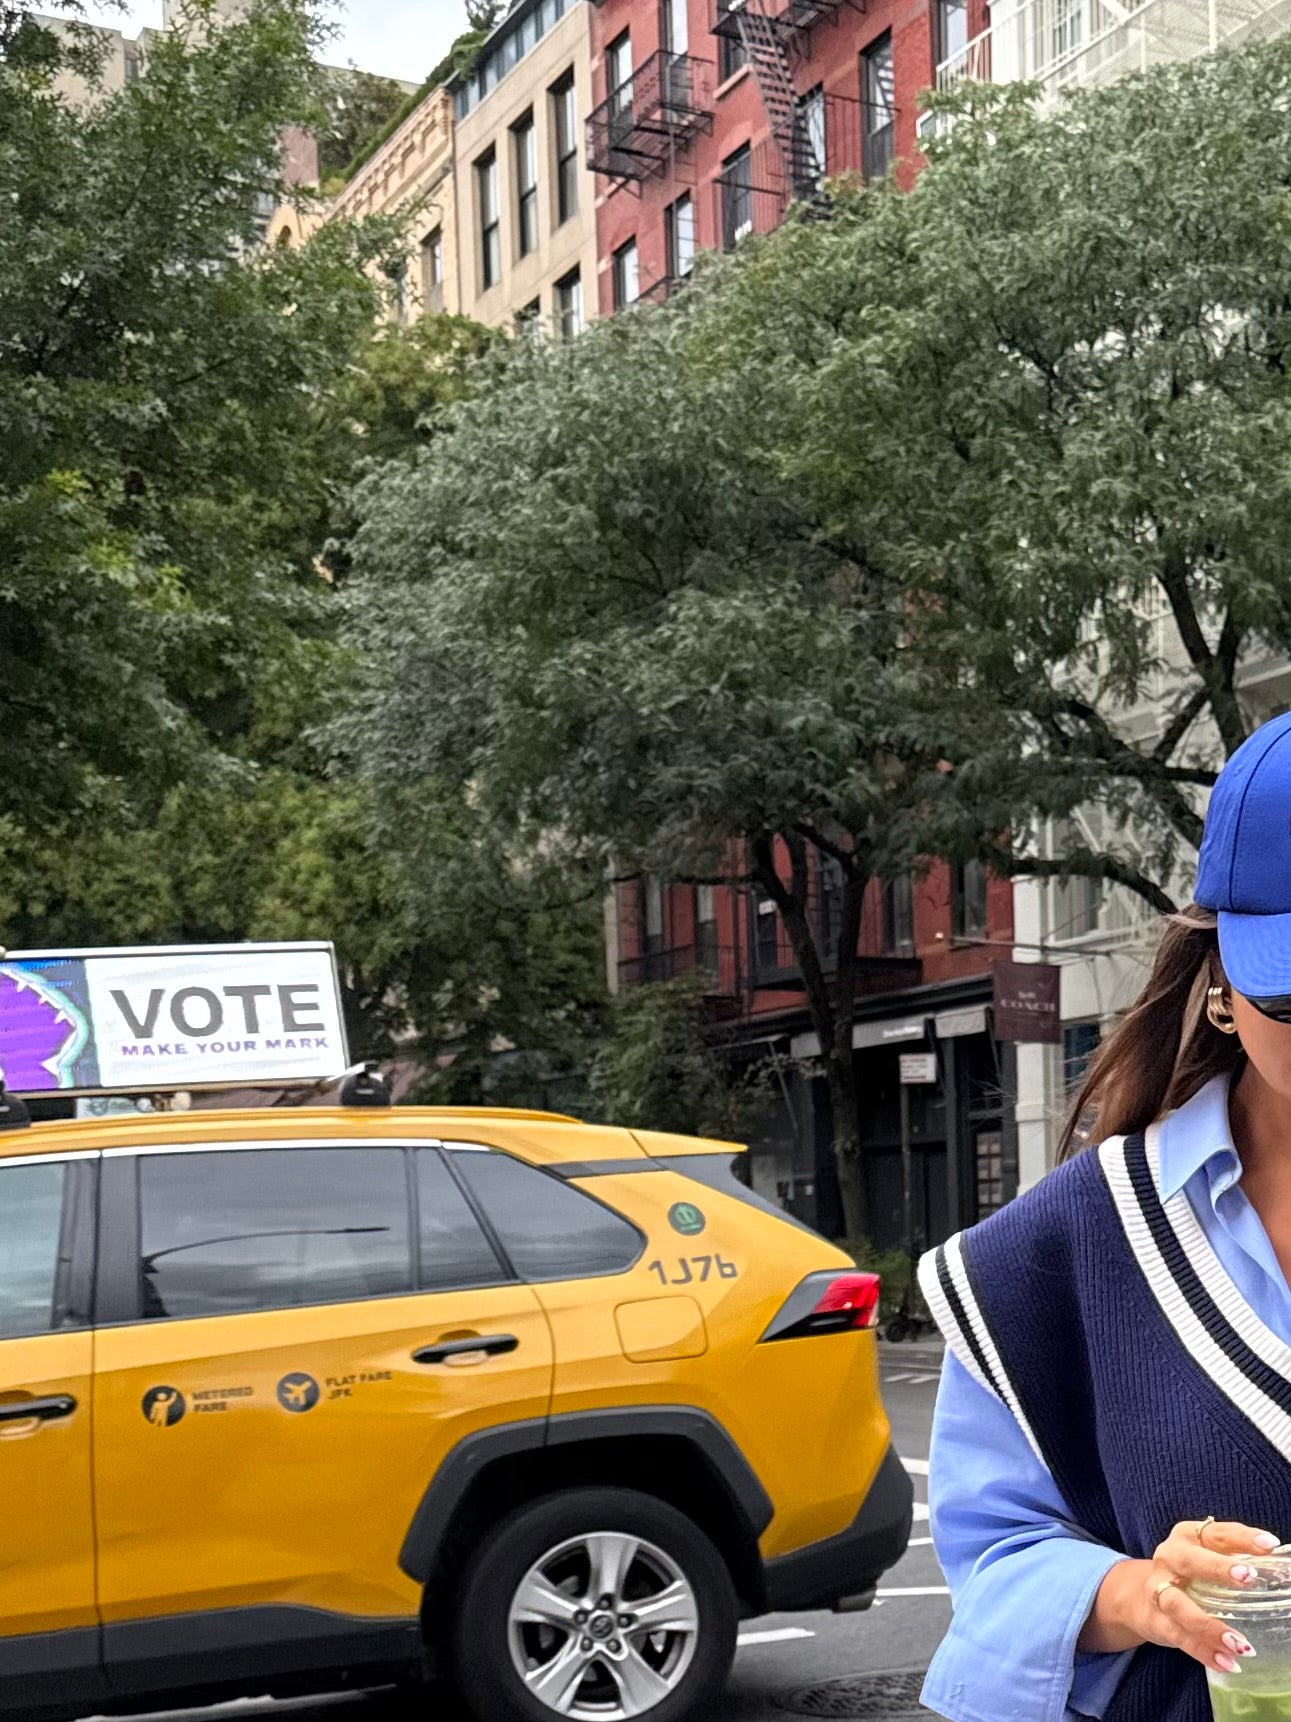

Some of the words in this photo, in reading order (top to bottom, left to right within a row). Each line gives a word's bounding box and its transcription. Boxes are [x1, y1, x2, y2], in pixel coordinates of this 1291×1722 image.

[109, 984, 325, 1037] VOTE
[121, 1043, 188, 1056] MAKE
[197, 1041, 256, 1054] YOUR
[266, 1037, 329, 1050] MARK
[648, 1253, 737, 1285] 1J76
[326, 1375, 356, 1387] FLAT
[360, 1371, 392, 1381] FARE
[192, 1386, 254, 1400] METERED
[194, 1401, 227, 1412] FARE
